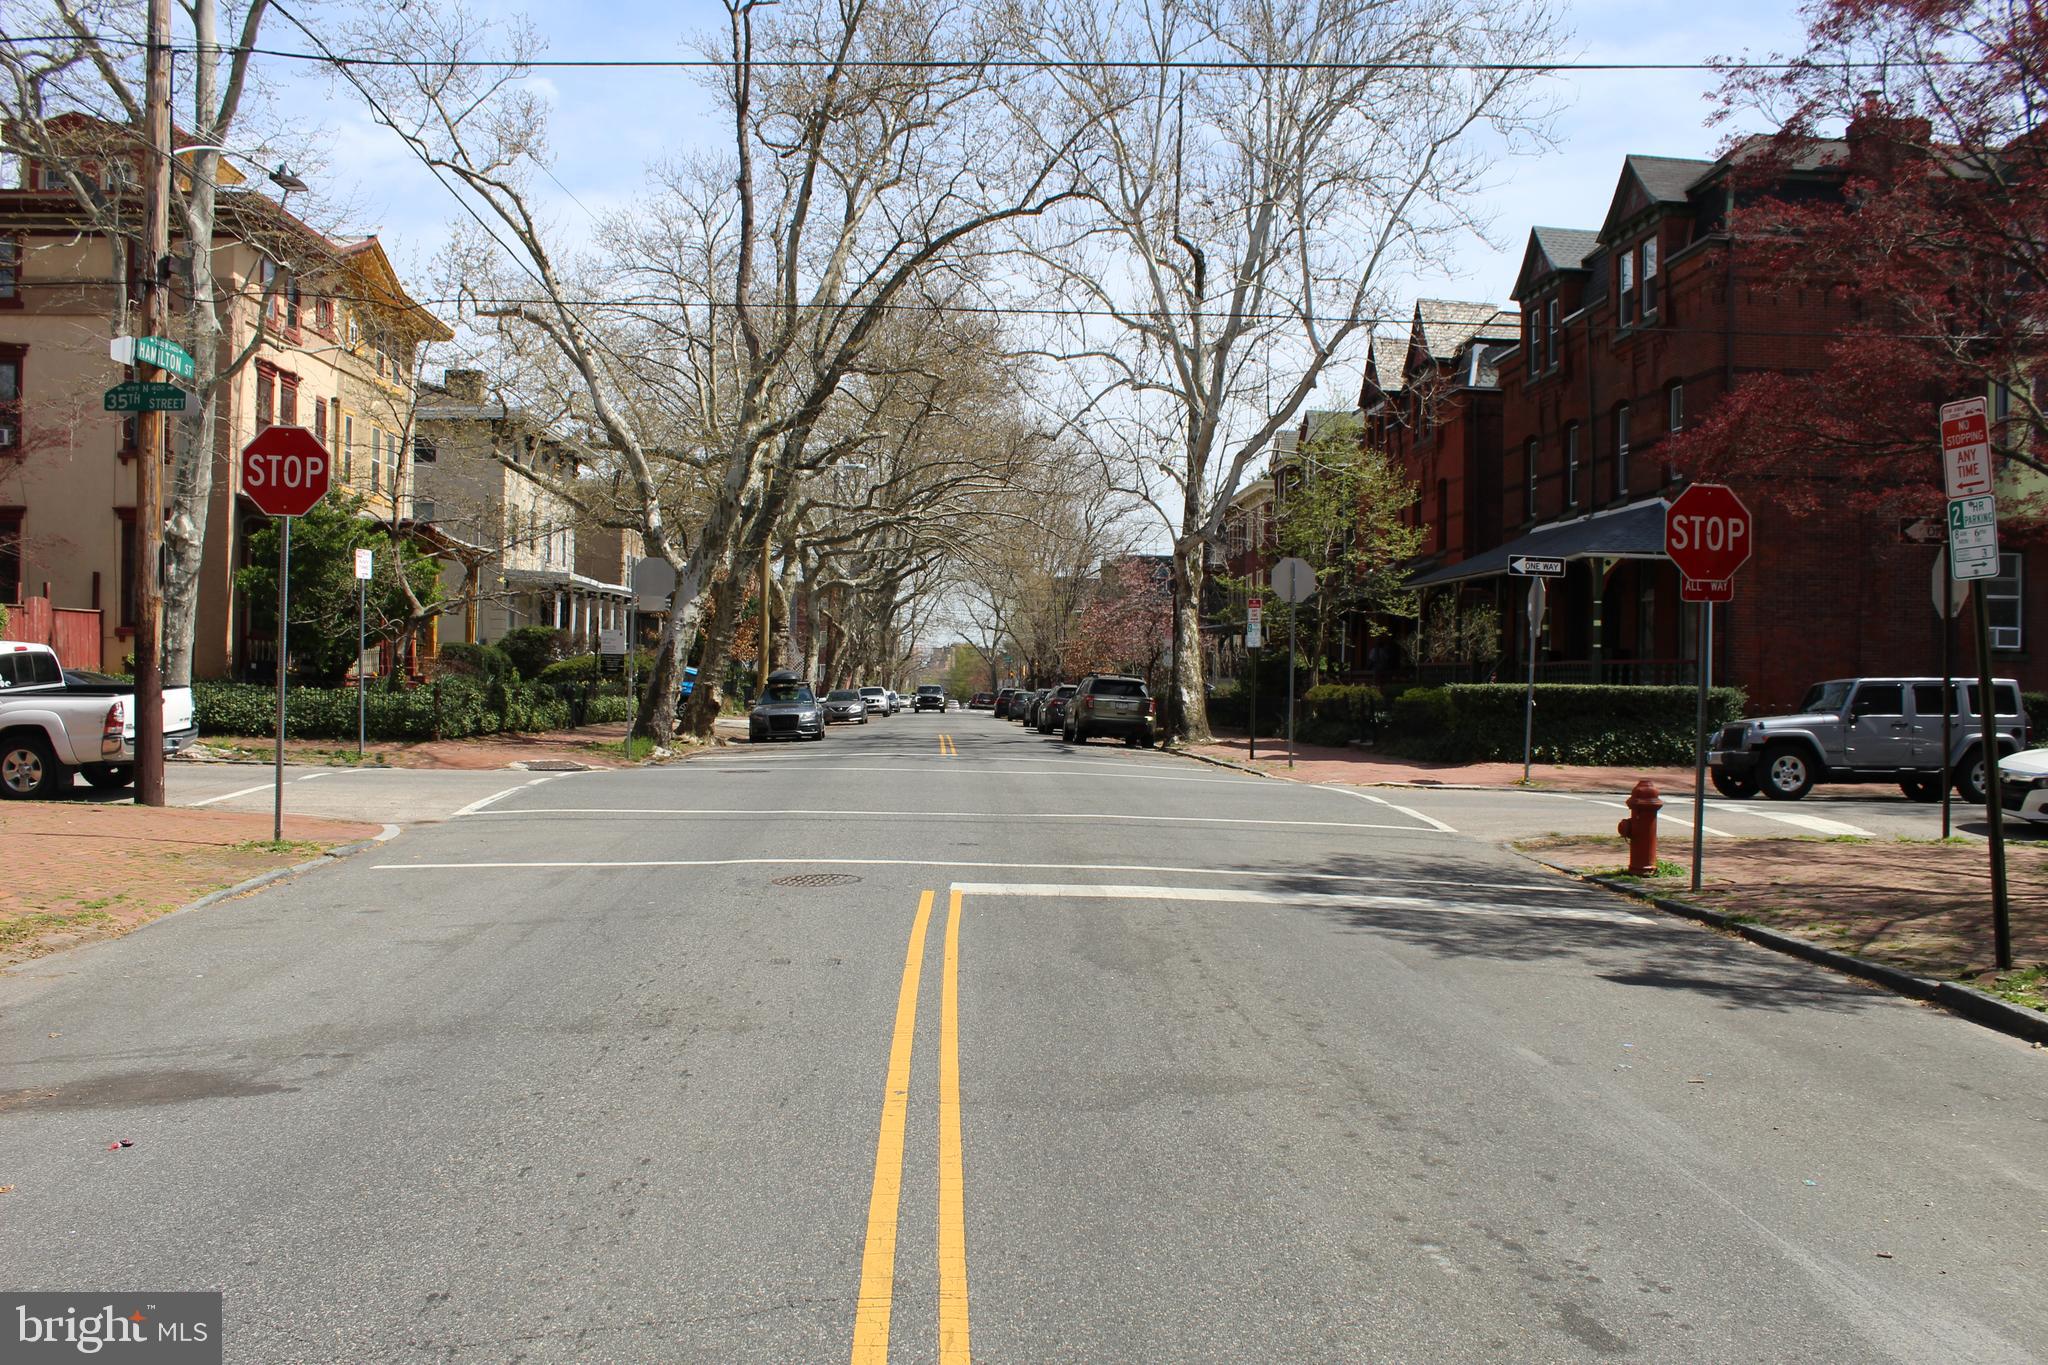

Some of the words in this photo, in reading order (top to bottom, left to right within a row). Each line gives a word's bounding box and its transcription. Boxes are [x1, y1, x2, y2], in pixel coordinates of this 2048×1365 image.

[138, 342, 182, 372] HAMILTON
[184, 363, 193, 377] ST
[142, 384, 149, 392] N
[107, 393, 141, 409] 35TH
[149, 398, 185, 409] STREET
[1958, 420, 1969, 431] NO
[1946, 430, 1984, 447] STOPPING
[1957, 448, 1977, 464] ANY
[247, 453, 324, 489] STOP
[1956, 463, 1980, 478] TIME
[1952, 506, 1961, 526] 2
[1972, 501, 1984, 512] HR
[1965, 512, 1993, 525] PARKING
[1671, 514, 1745, 552] STOP
[1525, 561, 1541, 570] ONE
[1543, 561, 1559, 571] WAY
[1685, 581, 1702, 591] ALL
[1711, 581, 1728, 591] WAY
